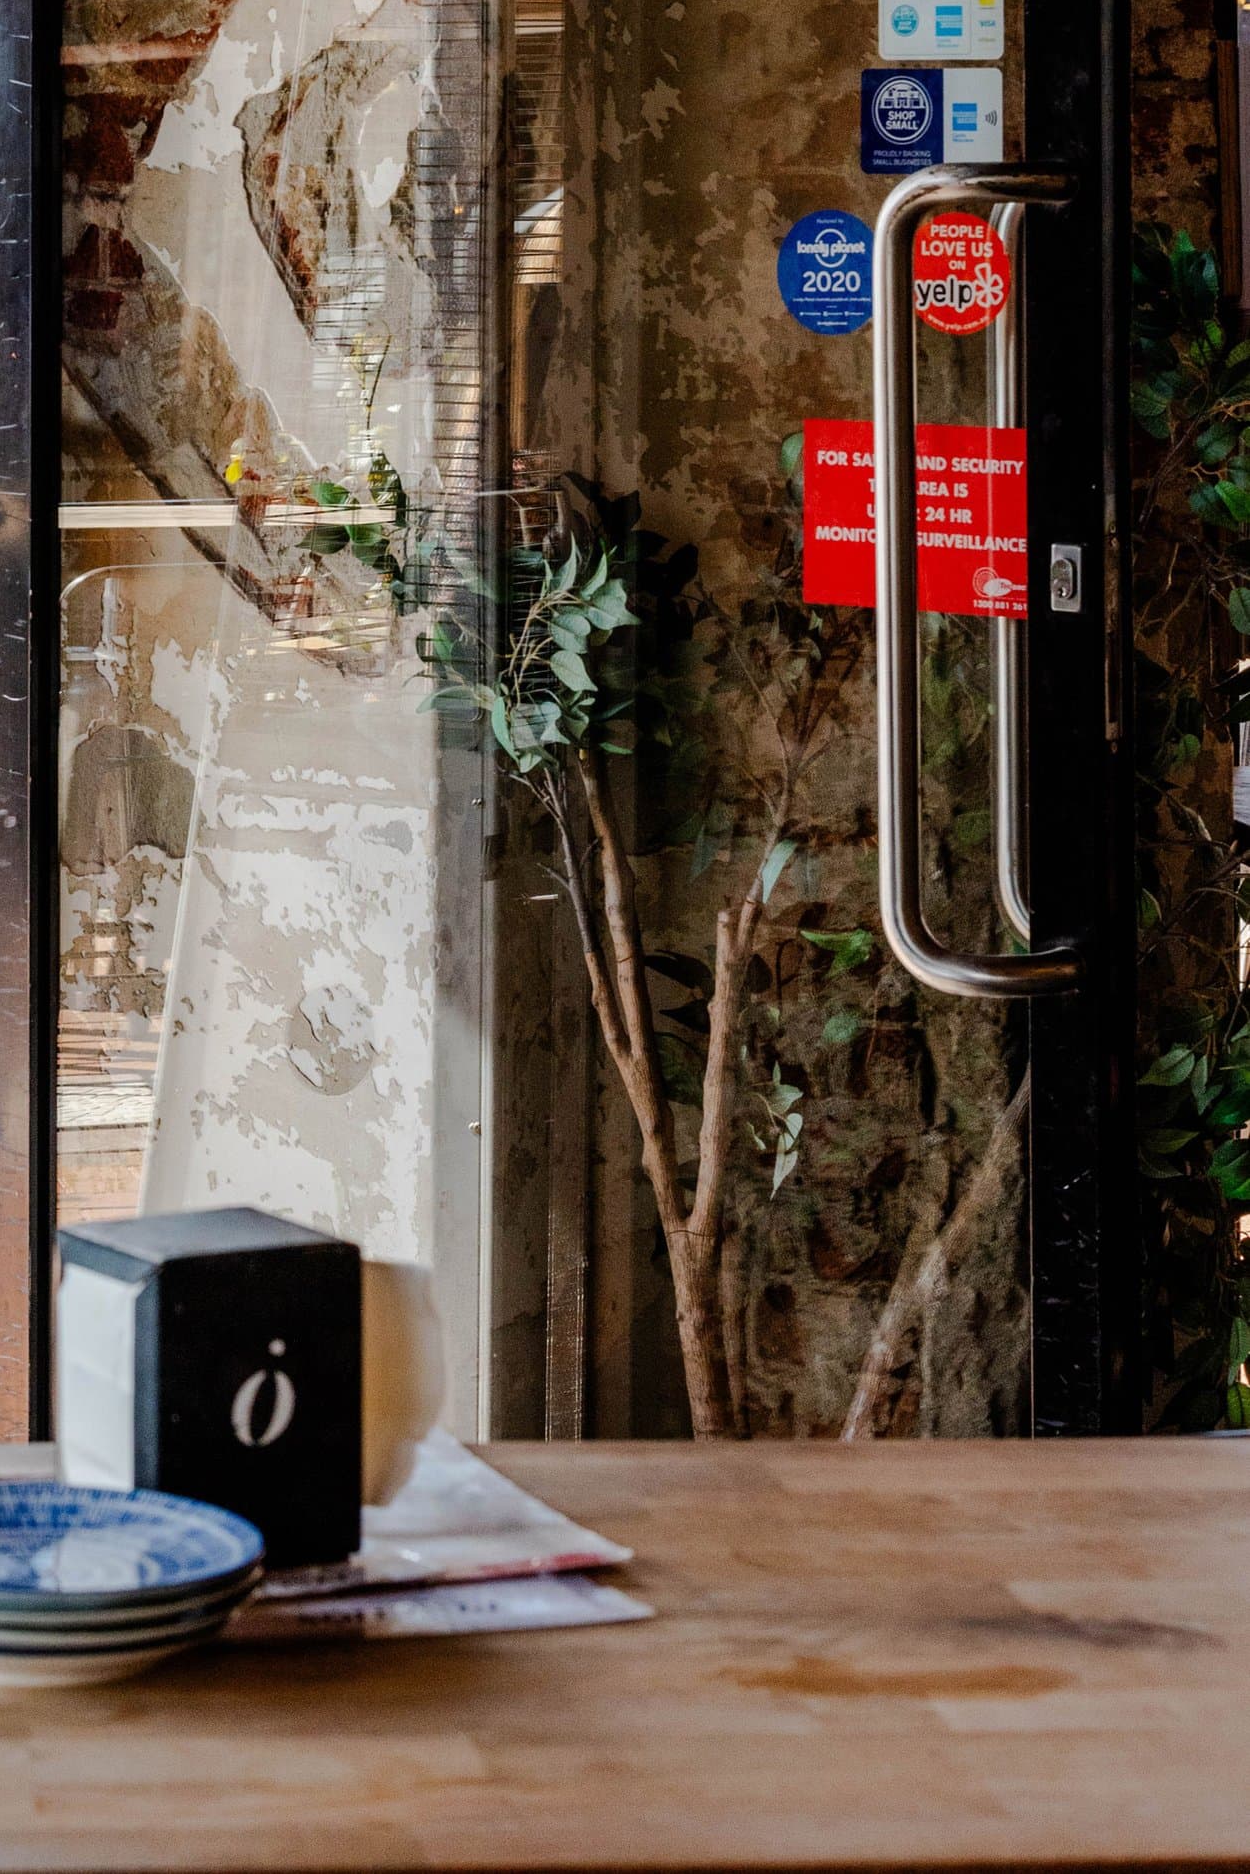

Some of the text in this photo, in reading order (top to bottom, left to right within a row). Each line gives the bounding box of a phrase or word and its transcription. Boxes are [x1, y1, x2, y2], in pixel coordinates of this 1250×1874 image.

[888, 111, 916, 121] SHOP
[885, 121, 918, 131] SMALL
[931, 225, 984, 238] PEOPLE
[797, 240, 866, 257] lonely planet
[921, 240, 994, 258] LOVE US
[949, 260, 967, 270] ON
[803, 271, 862, 292] 2020
[915, 275, 976, 313] yelp
[817, 450, 847, 466] FOR
[916, 456, 946, 471] AND
[951, 457, 1023, 475] SECURITY
[954, 483, 968, 498] IS
[925, 506, 972, 524] 24 HR
[815, 525, 1027, 553] MONITO SURVEILLANCE
